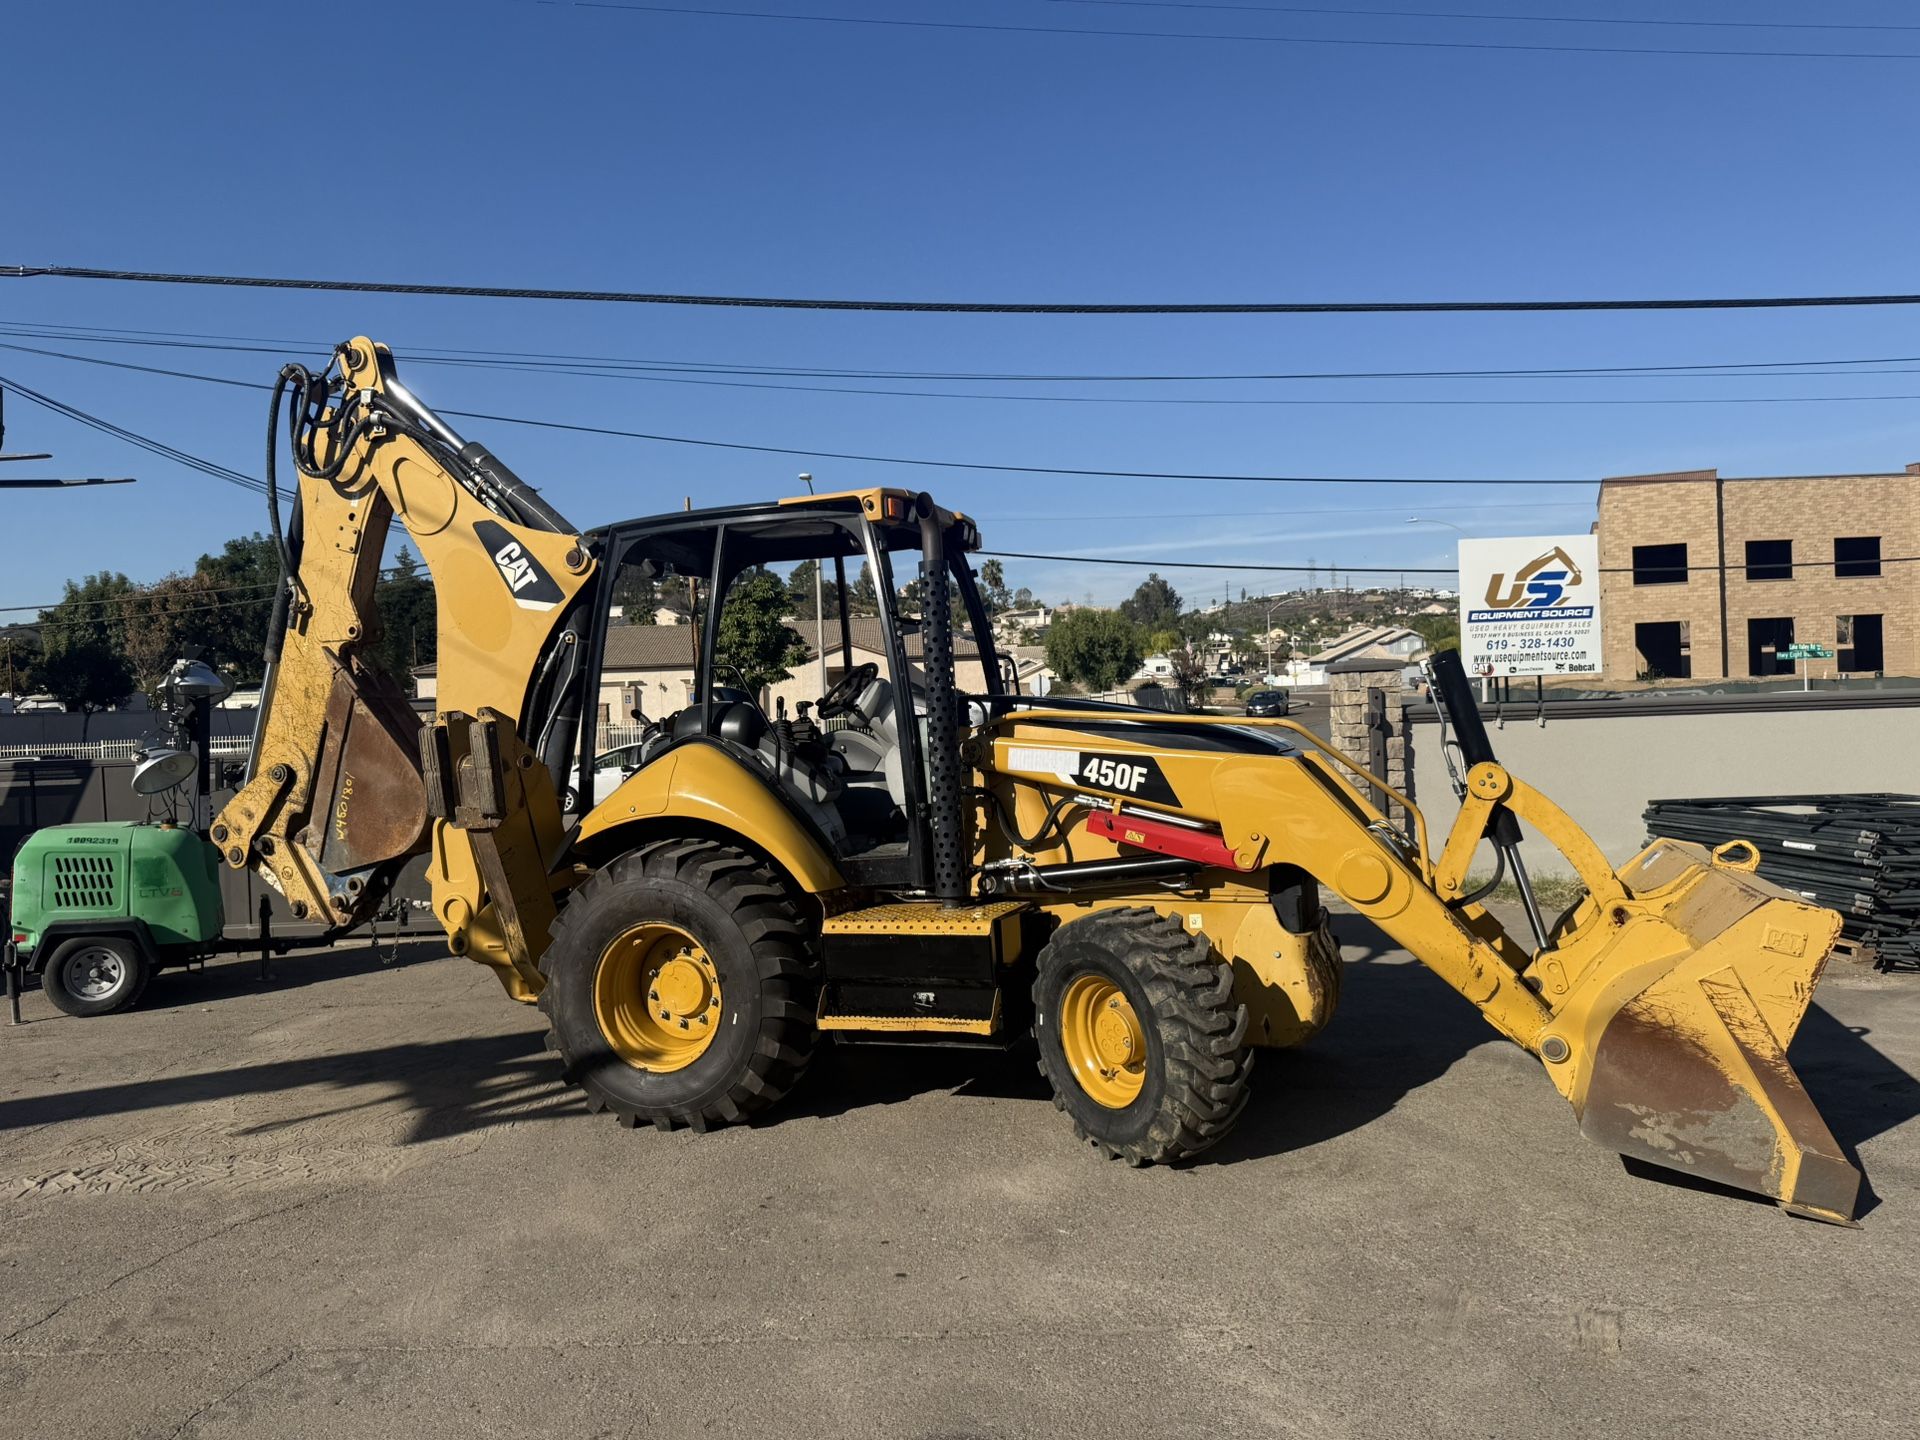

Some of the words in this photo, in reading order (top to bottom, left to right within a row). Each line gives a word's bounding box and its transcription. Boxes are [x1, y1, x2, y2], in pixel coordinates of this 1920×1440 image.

[495, 542, 538, 592] CAT
[1471, 611, 1541, 620] EQUIPMENT
[1541, 609, 1590, 618] SOURCE
[1520, 622, 1564, 630] EQUIPMENT
[1486, 640, 1508, 650] 619
[1520, 637, 1575, 649] 328-1430
[1474, 650, 1586, 665] www.usequipmentsource.com
[1472, 663, 1489, 674] CAT
[1568, 663, 1595, 672] Bobcat
[1083, 757, 1148, 792] 450F
